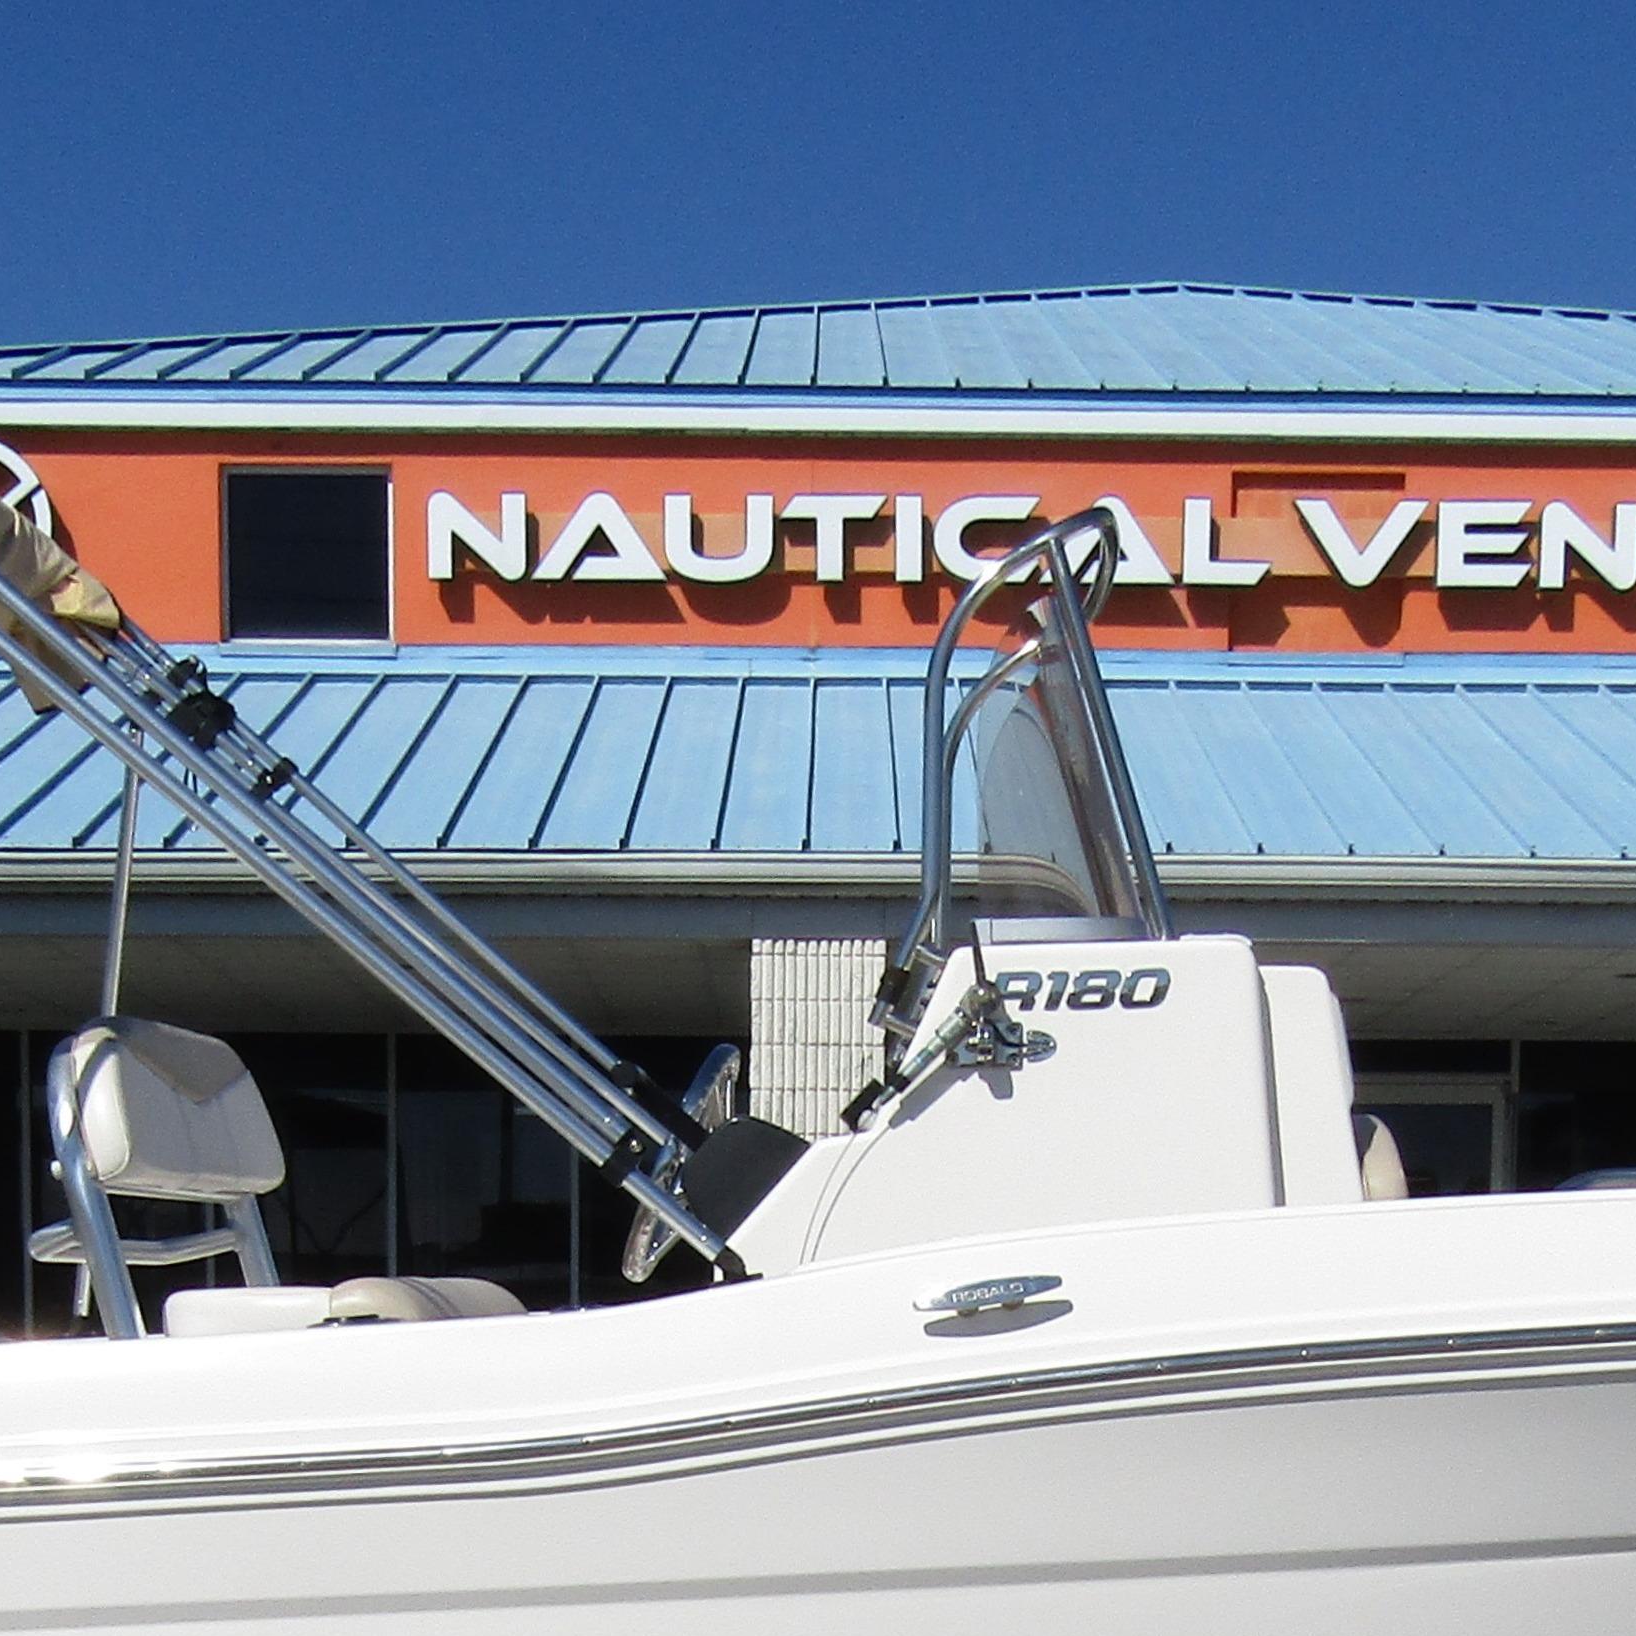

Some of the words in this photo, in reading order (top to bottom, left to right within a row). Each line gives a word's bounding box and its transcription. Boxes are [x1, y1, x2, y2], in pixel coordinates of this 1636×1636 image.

[426, 490, 1273, 586] NAUTICAL
[990, 967, 1171, 1011] R180
[951, 1282, 1024, 1303] ROBALO
